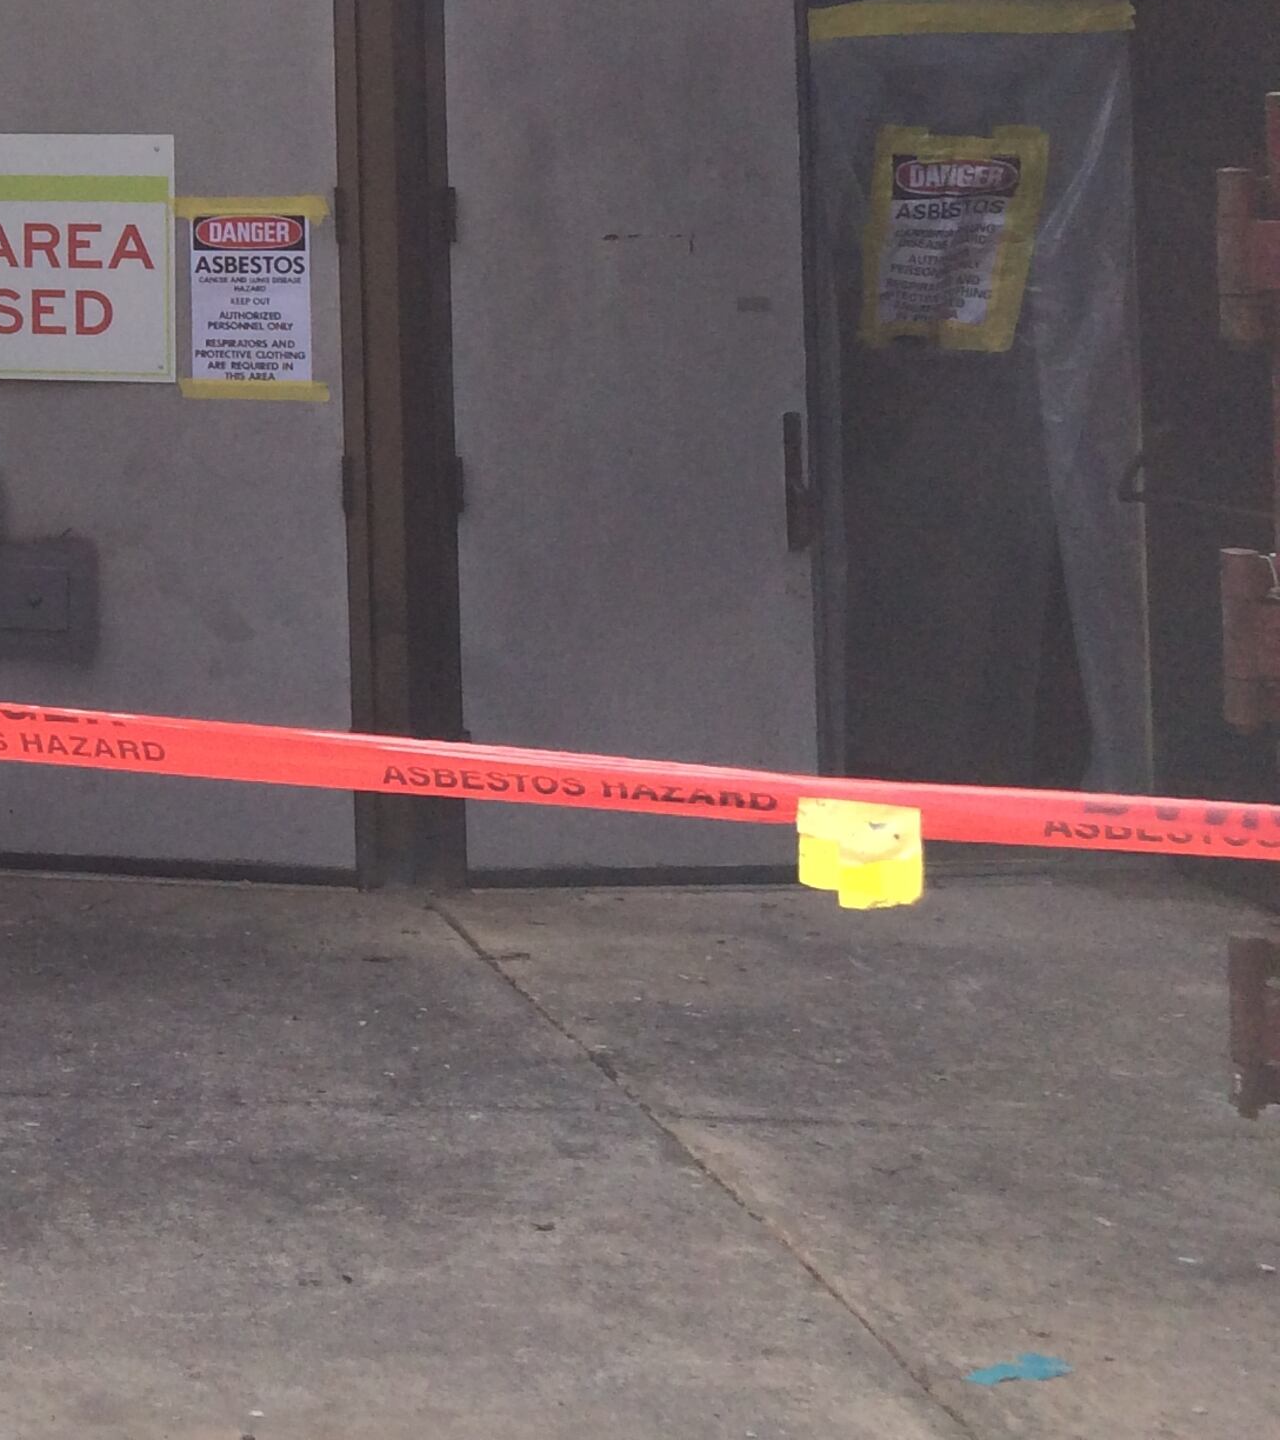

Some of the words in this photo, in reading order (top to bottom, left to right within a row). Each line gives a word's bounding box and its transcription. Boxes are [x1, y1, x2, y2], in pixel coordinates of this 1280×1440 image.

[909, 164, 1005, 188] DANGER
[895, 199, 1005, 220] ASBESTOS
[209, 222, 290, 243] DANGER
[195, 256, 305, 274] ASBESTOS
[230, 297, 251, 305] KEEP
[252, 297, 270, 305] OUT
[219, 311, 281, 320] AUTHORIZED
[208, 321, 264, 330] PERSONNEL
[267, 322, 293, 331] ONLY
[205, 339, 268, 348] RESPIRATORS
[271, 339, 295, 348] AND
[194, 349, 252, 359] PROTECTIVE
[255, 350, 306, 360] CLOTHING
[207, 361, 226, 370] ARE
[231, 361, 279, 371] REQUIRED
[282, 362, 294, 371] IN
[225, 372, 245, 380] THIS
[248, 372, 276, 381] AREA
[20, 732, 167, 763] HAZARD
[382, 765, 586, 797] ASBESTOS
[601, 778, 778, 812] HAZARD
